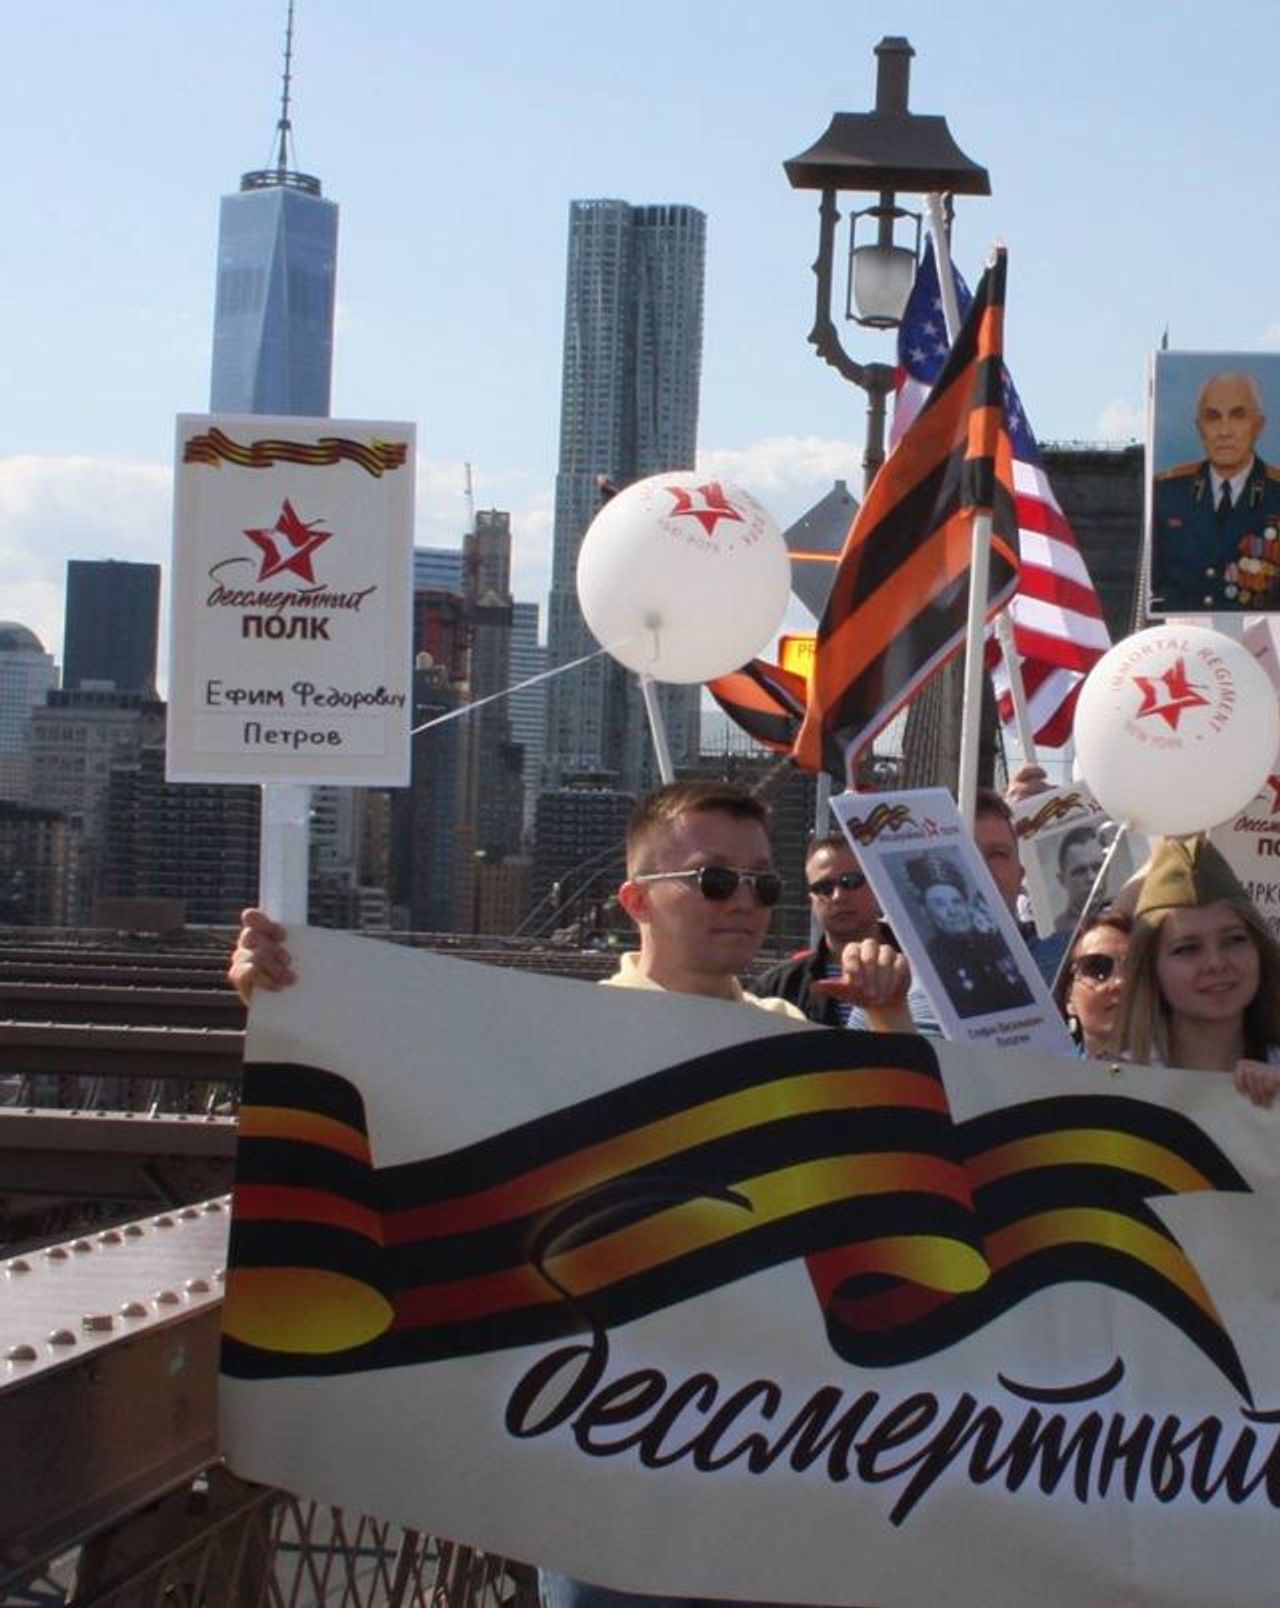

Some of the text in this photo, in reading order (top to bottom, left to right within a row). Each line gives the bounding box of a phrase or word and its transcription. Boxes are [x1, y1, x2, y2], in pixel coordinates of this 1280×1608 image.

[206, 566, 377, 614] бессмертный
[241, 615, 331, 641] ПОЛК
[243, 722, 343, 749] Петров
